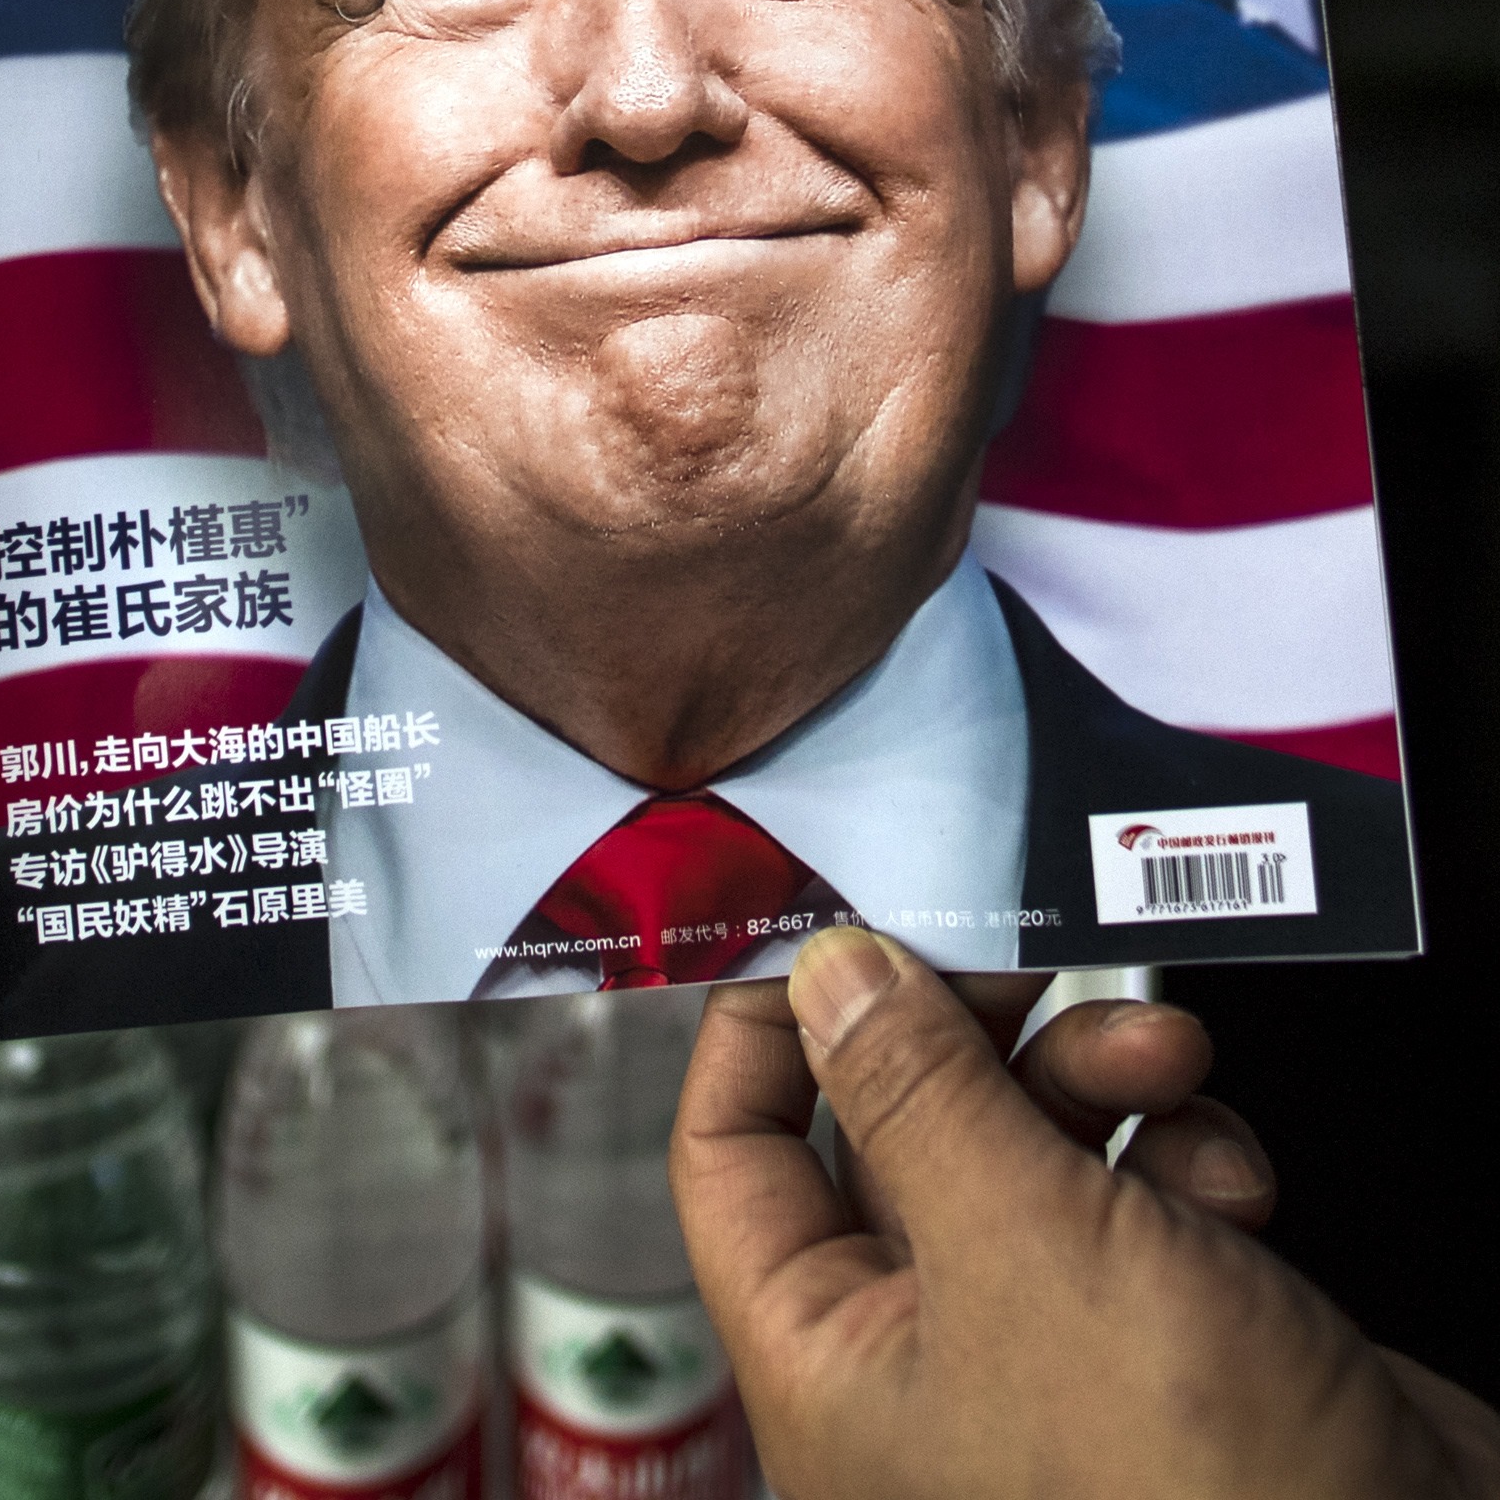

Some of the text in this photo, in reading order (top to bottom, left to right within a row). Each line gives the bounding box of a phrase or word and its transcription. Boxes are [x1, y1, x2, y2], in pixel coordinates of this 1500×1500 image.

[0, 711, 441, 783] 郭川,走向大海的中国船长
[6, 764, 432, 838] 房价为什么跳不出“怪圈”
[9, 828, 329, 890] 专访《驴得水》导演
[17, 879, 368, 945] “国民妖精”石原里美
[474, 932, 642, 961] www.hqrw.com.cn
